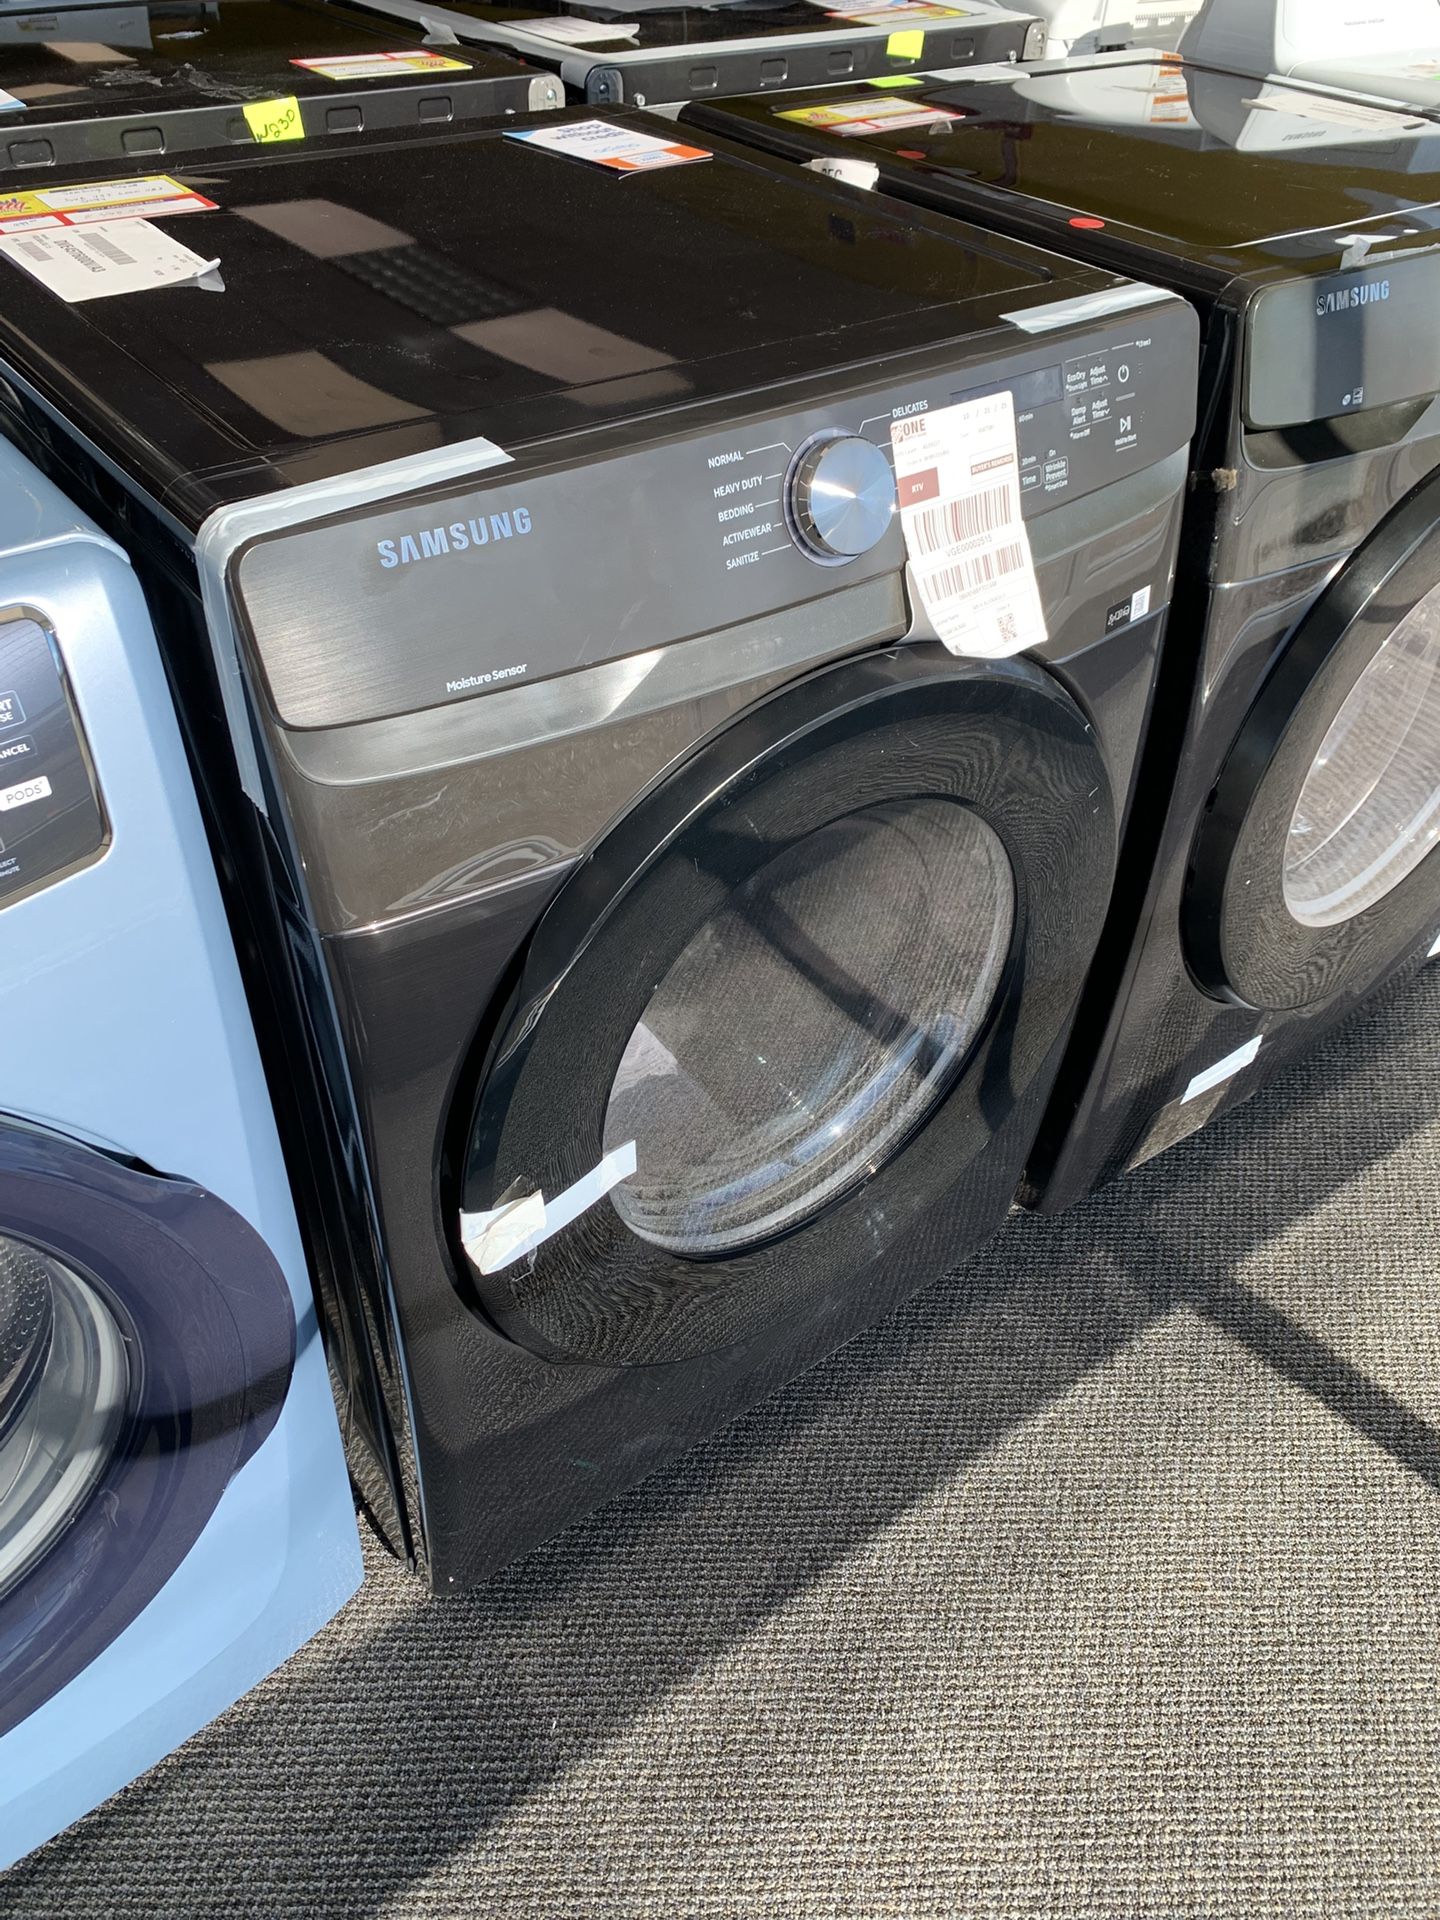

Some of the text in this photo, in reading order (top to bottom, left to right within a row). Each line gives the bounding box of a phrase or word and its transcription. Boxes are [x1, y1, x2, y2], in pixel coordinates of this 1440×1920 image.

[1316, 280, 1390, 316] SAMSUNG
[892, 400, 929, 418] DELICATES
[903, 418, 926, 437] ONE
[708, 451, 744, 469] NORMAL
[713, 475, 763, 498] HEAVY DUTY
[911, 482, 924, 494] RTV
[718, 504, 754, 522] BEDDING
[377, 507, 532, 568] SAMSUNG
[722, 523, 772, 546] ACTIVEWEAR
[726, 551, 760, 570] SANITIZE
[446, 663, 528, 692] Moisture Sensor
